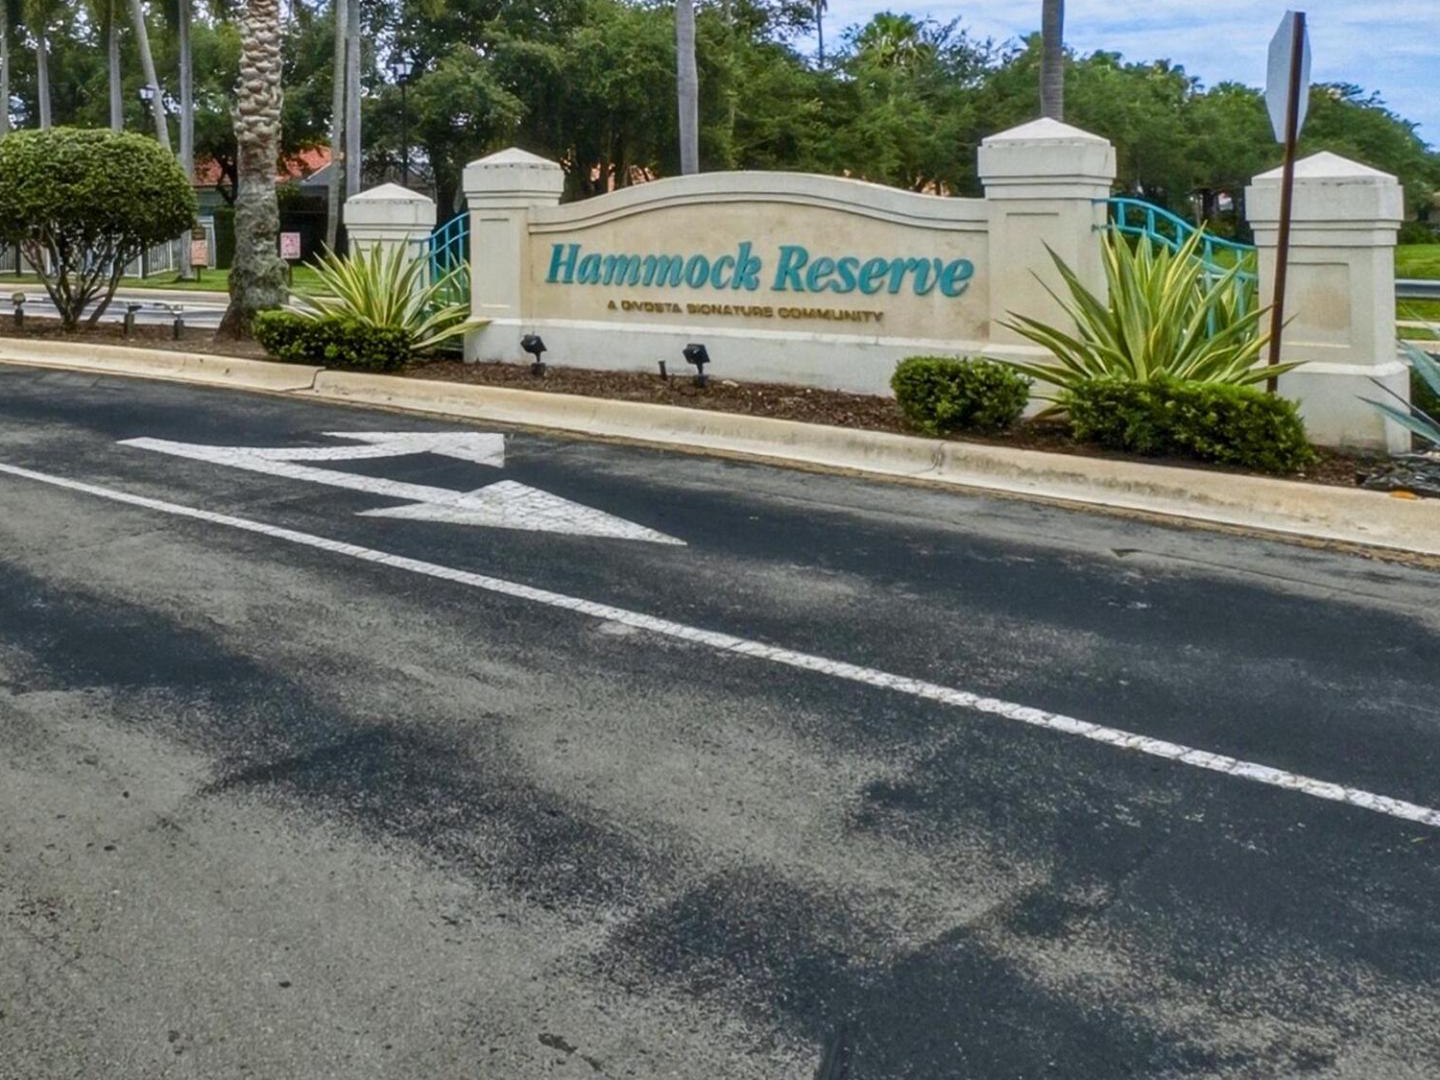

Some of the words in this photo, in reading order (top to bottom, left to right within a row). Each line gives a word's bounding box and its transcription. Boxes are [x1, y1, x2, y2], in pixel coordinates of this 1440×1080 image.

[545, 241, 763, 292] Hammock
[771, 243, 976, 298] Reserve
[607, 300, 618, 310] A
[687, 303, 774, 319] SIGNATURE
[777, 307, 885, 323] COMMUNITY
